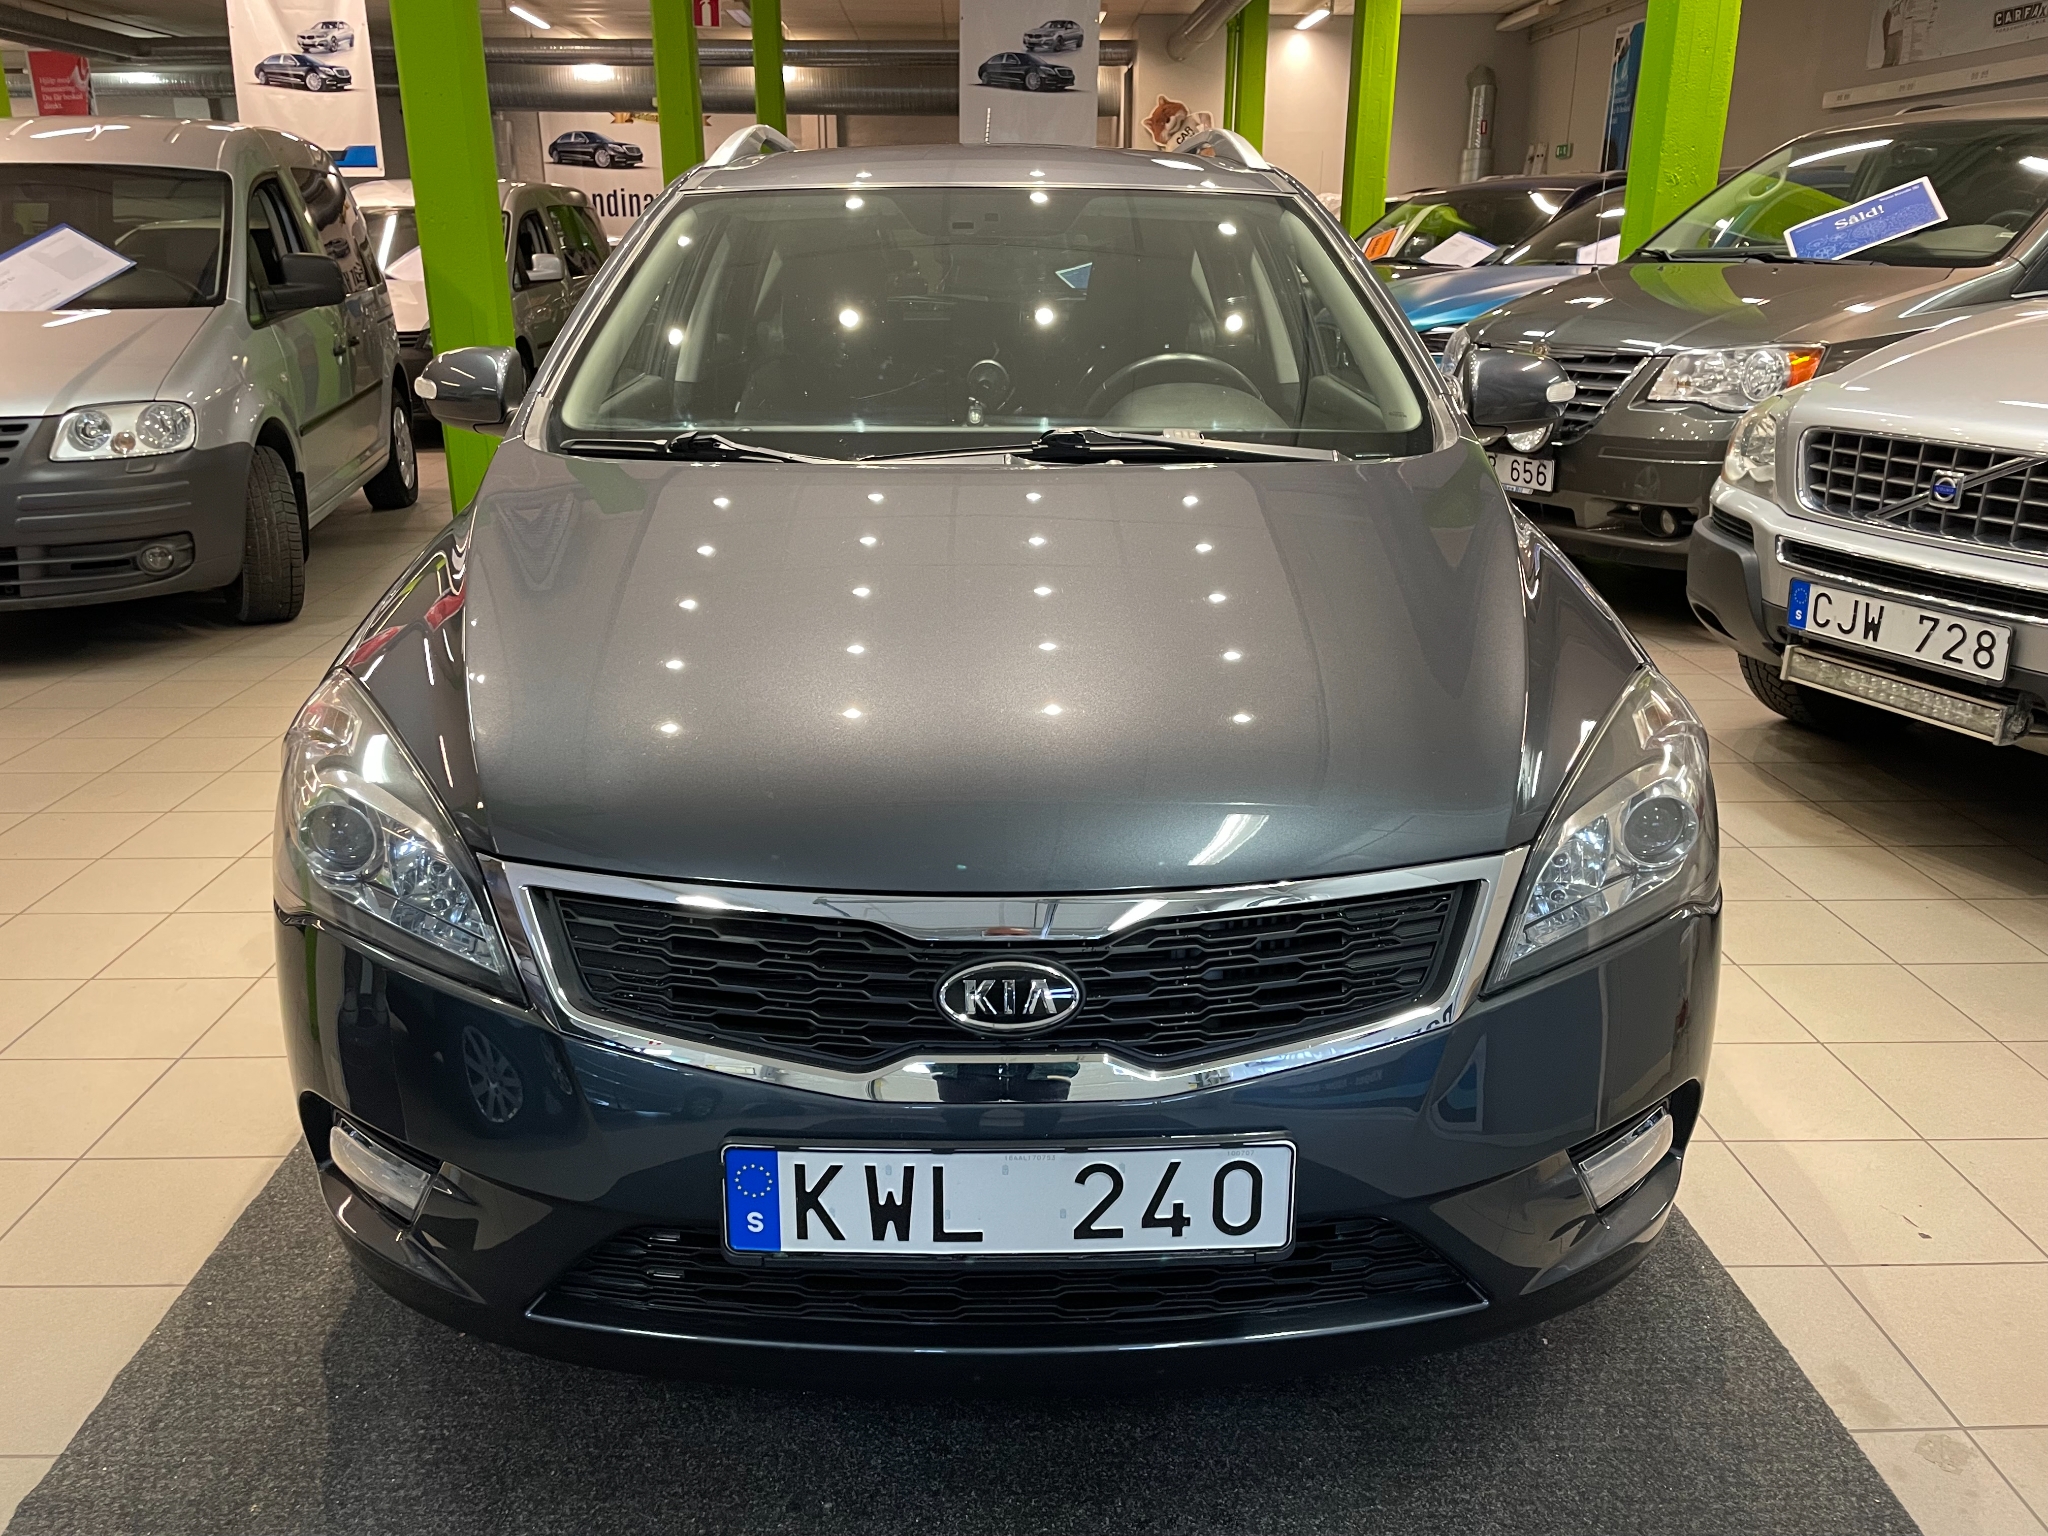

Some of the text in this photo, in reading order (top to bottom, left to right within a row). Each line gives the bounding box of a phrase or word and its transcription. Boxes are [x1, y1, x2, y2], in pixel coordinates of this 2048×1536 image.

[43, 93, 53, 101] Du
[1176, 126, 1195, 145] CAR
[592, 188, 659, 217] ndina
[1834, 204, 1885, 230] Såld!
[1510, 459, 1547, 486] 656
[1795, 609, 1803, 620] S
[1812, 592, 1997, 669] CJW 728
[962, 979, 1058, 1015] KIA
[794, 1159, 1263, 1243] KWL 240
[746, 1211, 765, 1233] S
